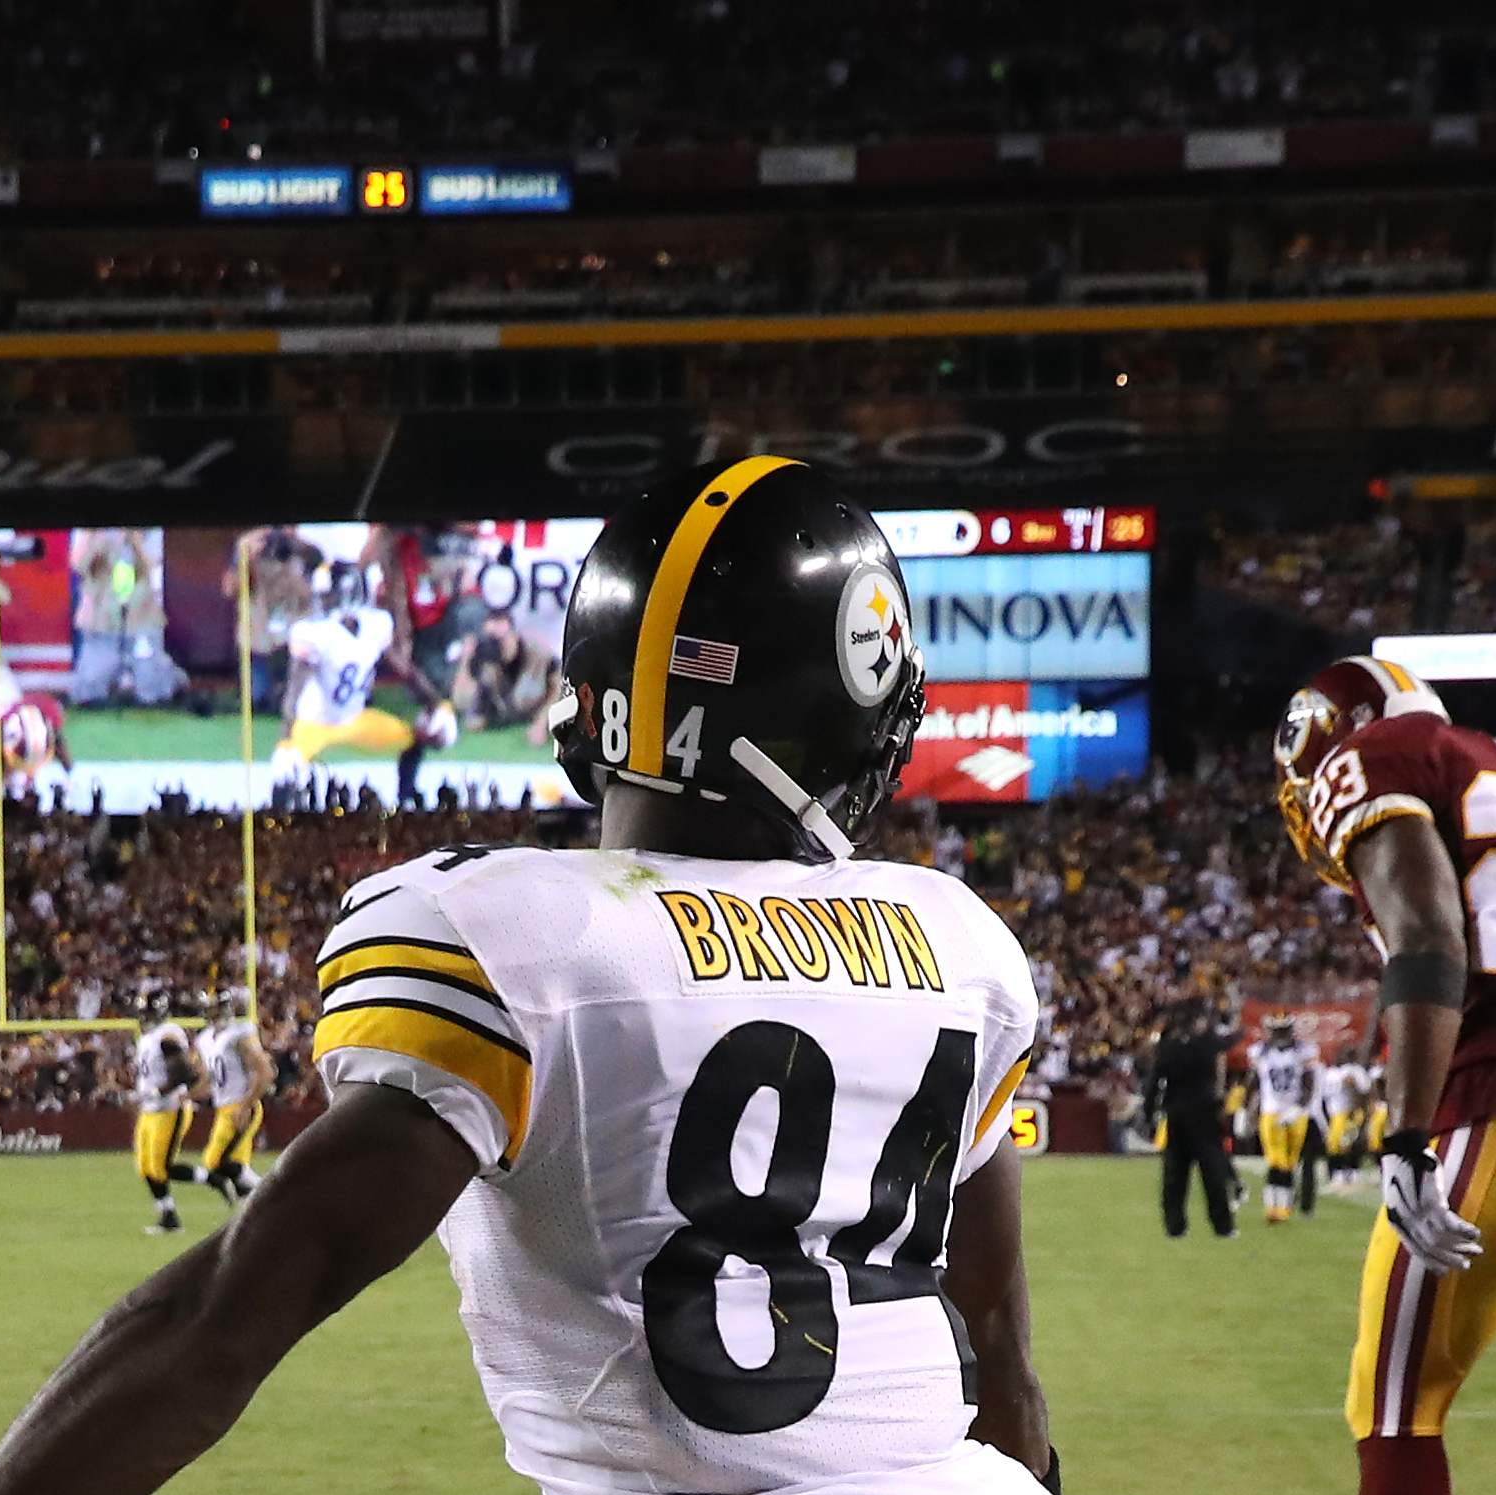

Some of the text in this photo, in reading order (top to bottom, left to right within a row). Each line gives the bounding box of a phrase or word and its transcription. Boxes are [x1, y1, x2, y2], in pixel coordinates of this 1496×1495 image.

[364, 171, 405, 208] 25
[929, 593, 1133, 643] INOVA
[956, 704, 990, 739] of
[990, 704, 1118, 738] America
[1308, 749, 1368, 840] 23
[656, 890, 944, 993] BROWN
[643, 1020, 978, 1434] 84
